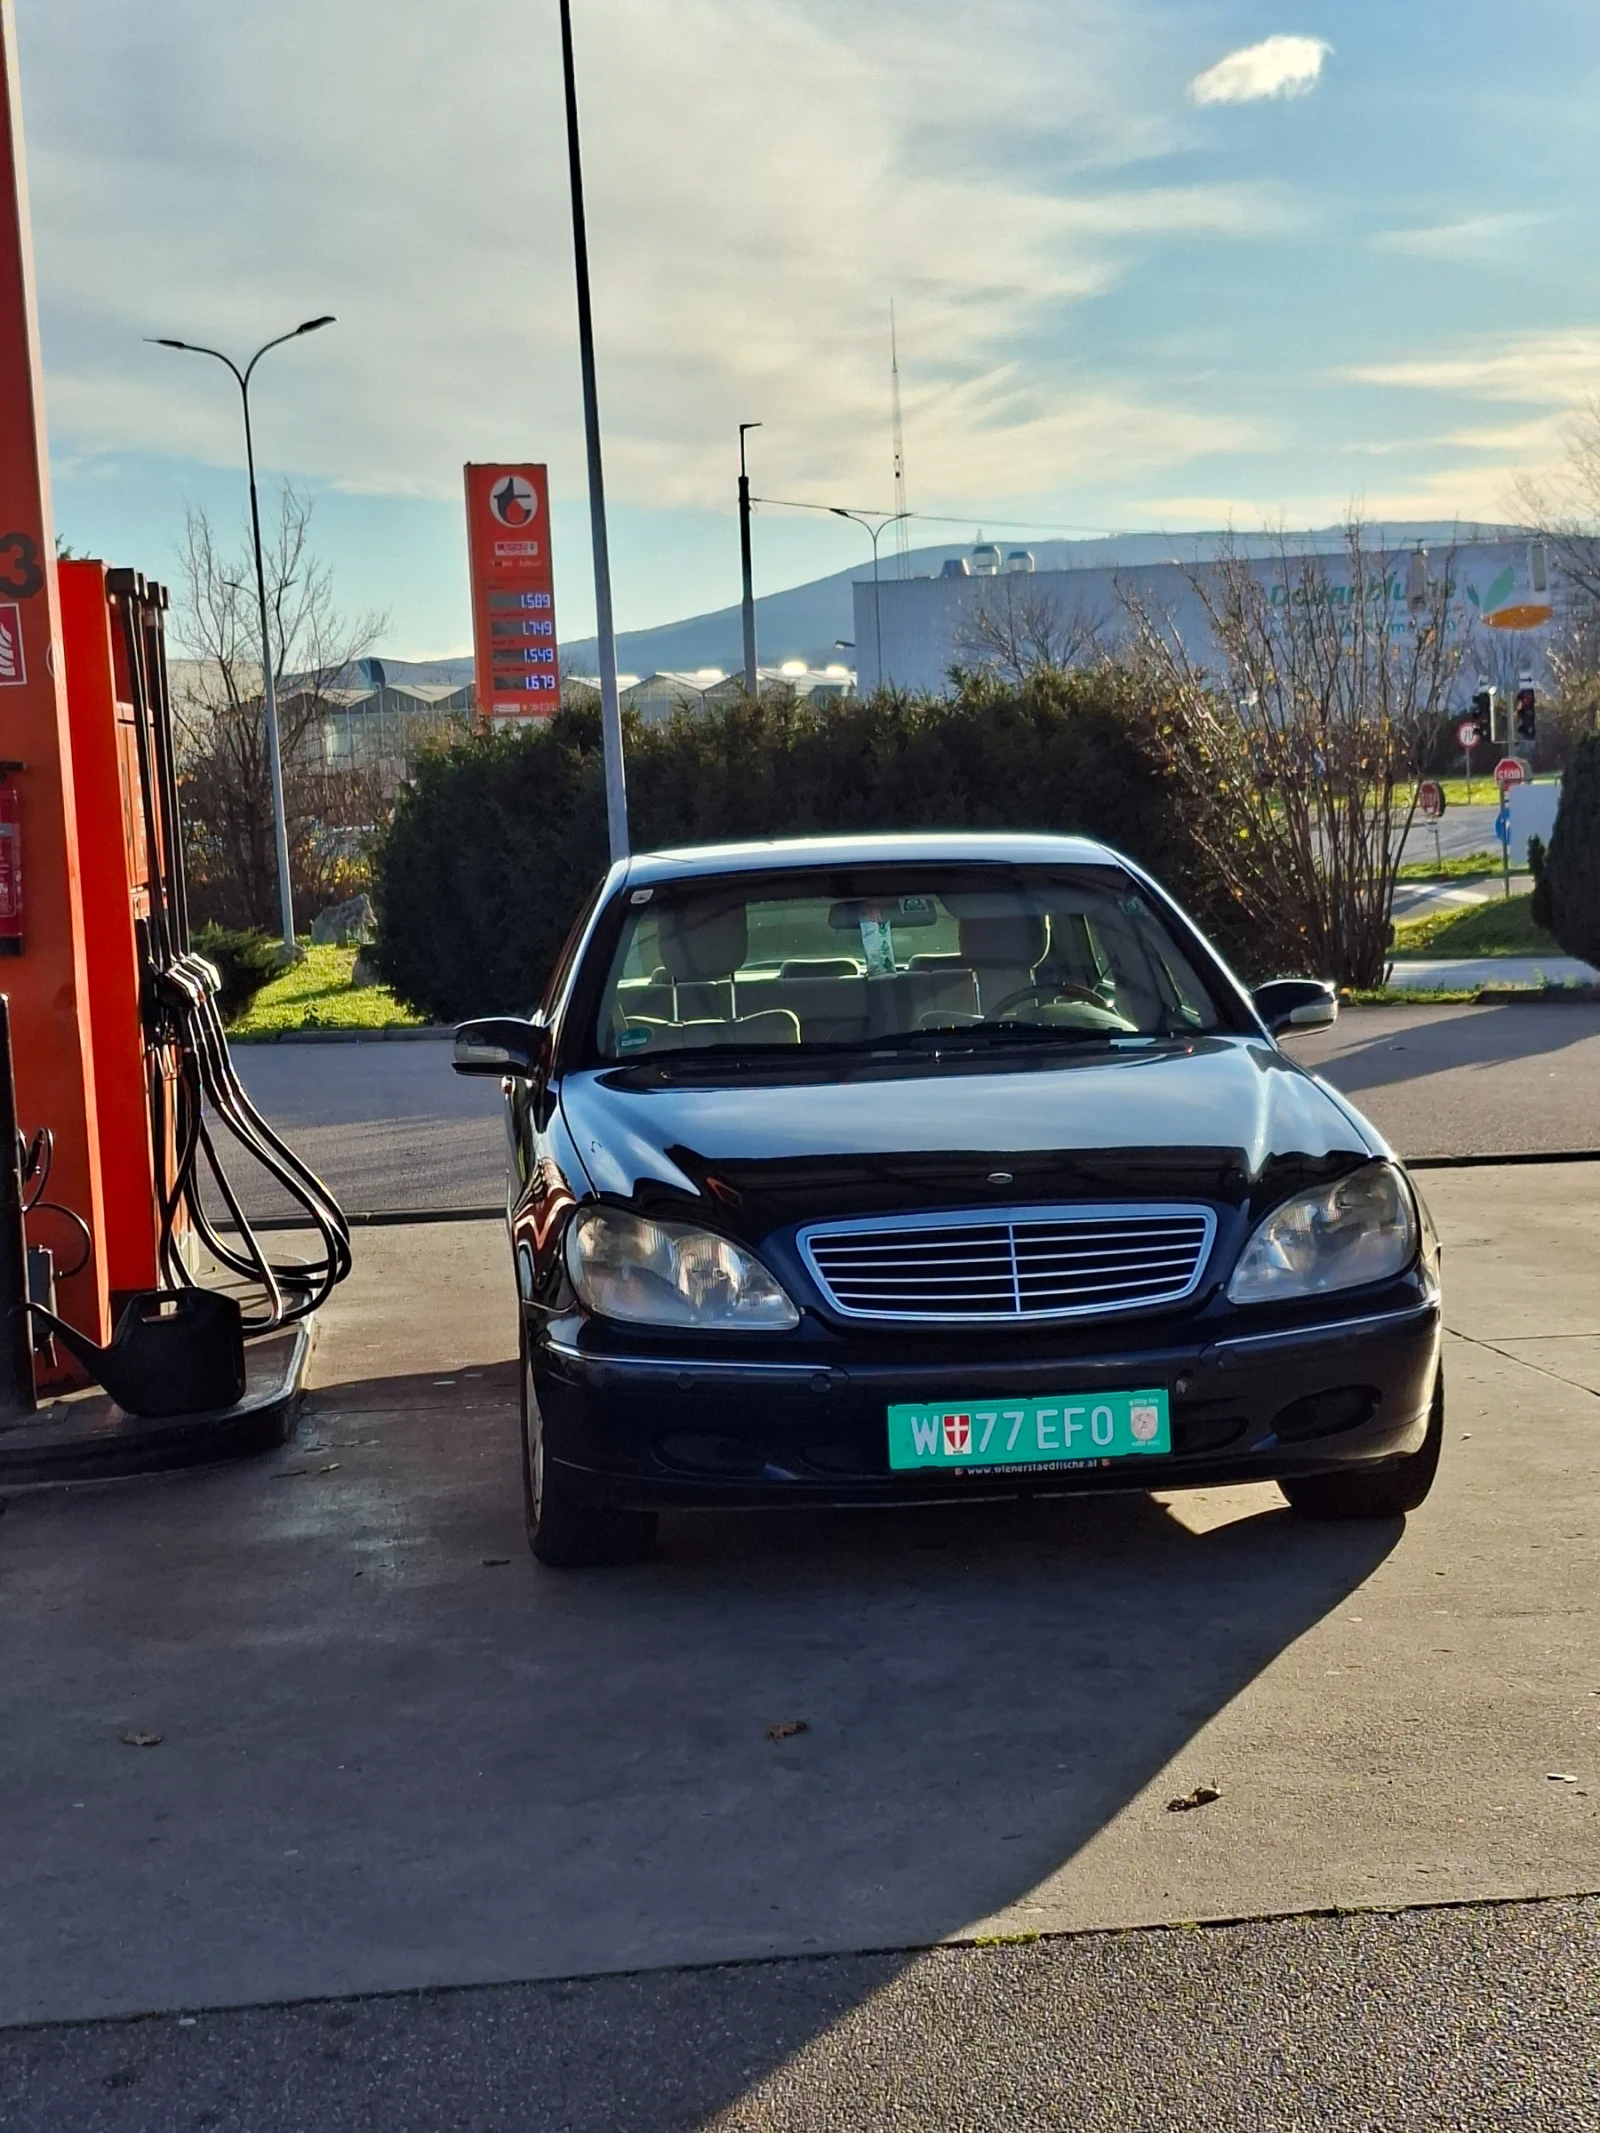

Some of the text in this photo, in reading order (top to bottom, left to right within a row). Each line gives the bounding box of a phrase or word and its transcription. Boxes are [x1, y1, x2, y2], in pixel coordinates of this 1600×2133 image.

[0, 532, 43, 598] 3
[524, 648, 554, 663] 1.549
[525, 675, 555, 690] 1.679
[910, 1415, 939, 1456] W
[975, 1411, 1025, 1453] 77
